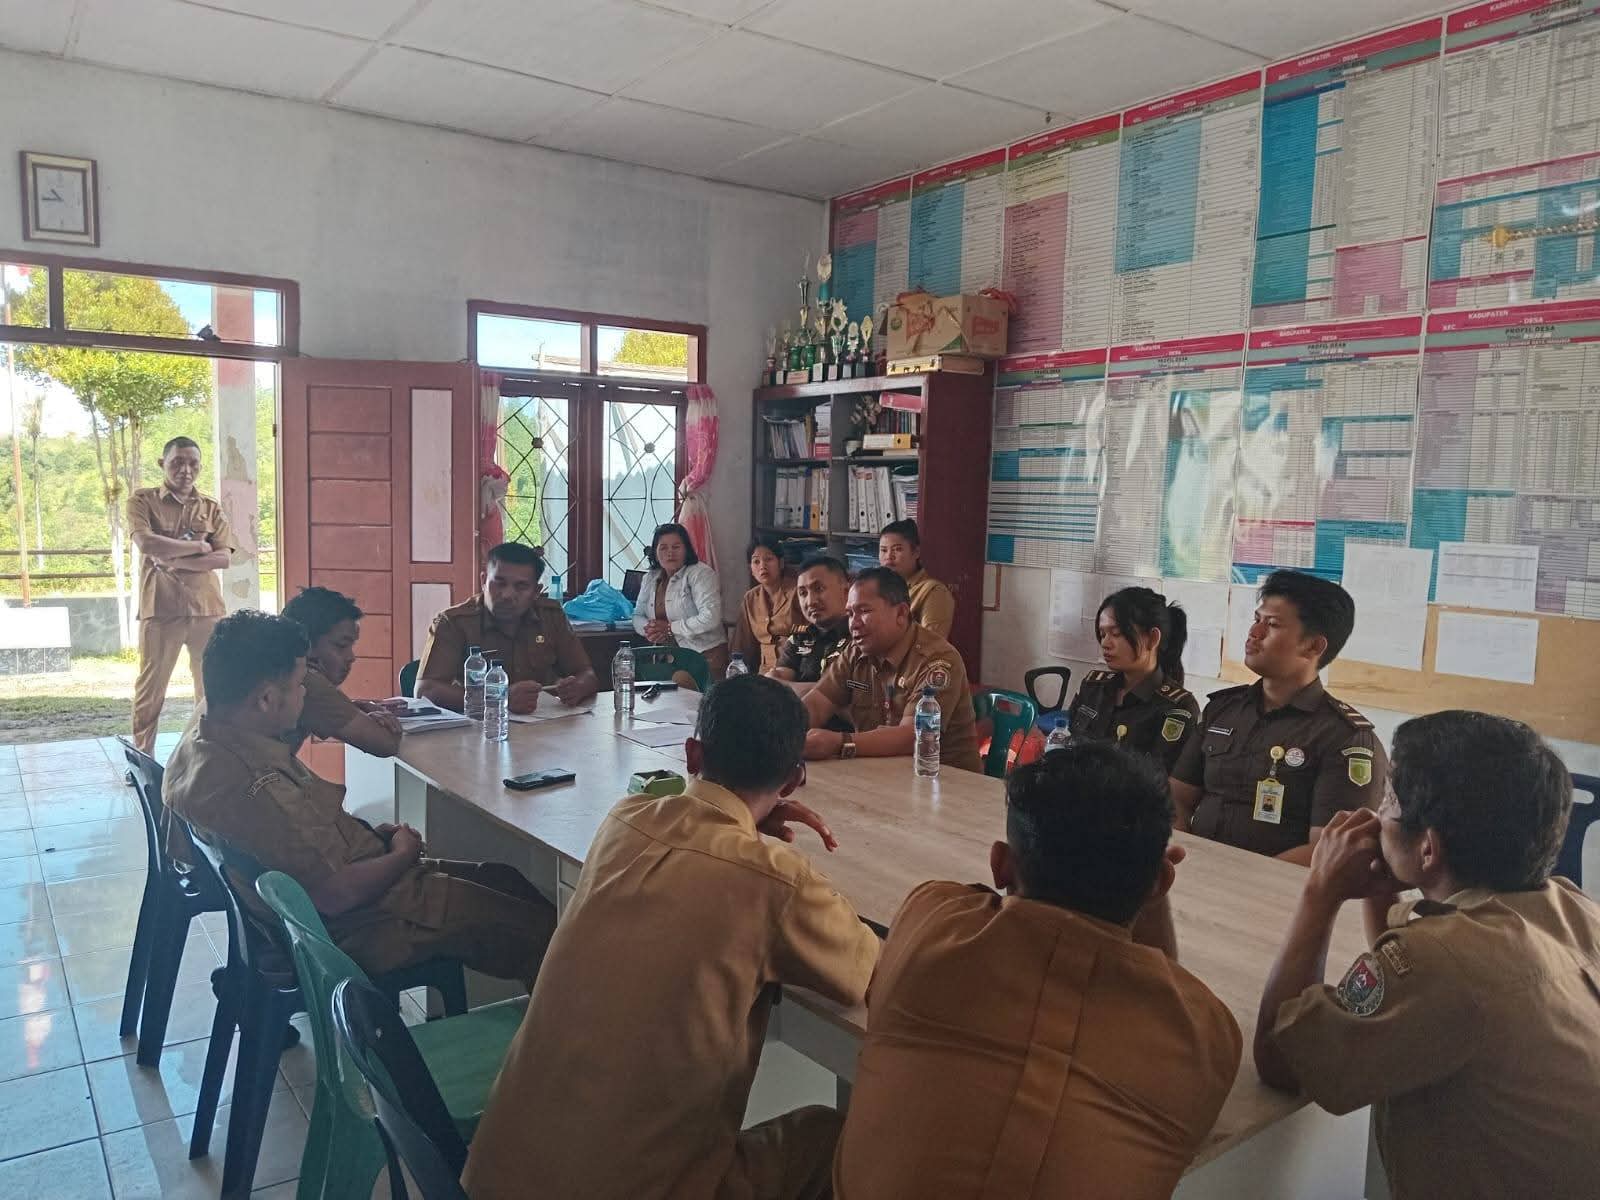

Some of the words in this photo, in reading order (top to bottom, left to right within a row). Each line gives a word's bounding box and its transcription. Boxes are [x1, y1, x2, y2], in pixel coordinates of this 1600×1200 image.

[1468, 311, 1509, 320] KABUPATEN
[1524, 317, 1544, 325] DESA
[1505, 327, 1533, 335] PROFIL
[1534, 325, 1556, 333] DESA
